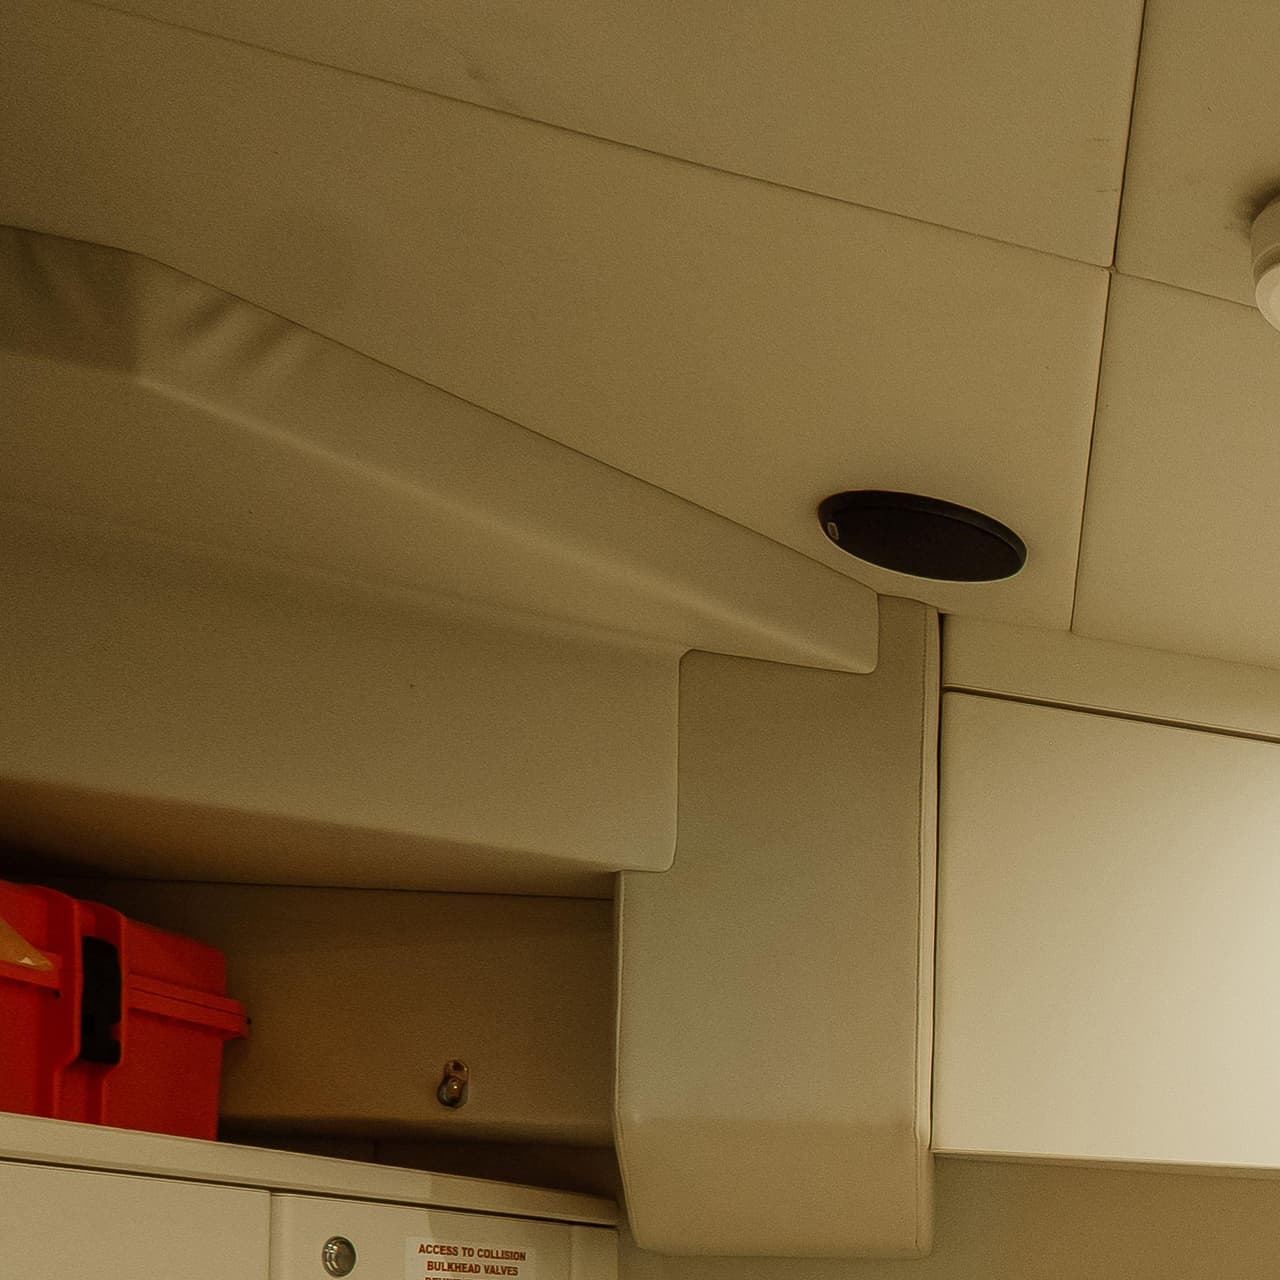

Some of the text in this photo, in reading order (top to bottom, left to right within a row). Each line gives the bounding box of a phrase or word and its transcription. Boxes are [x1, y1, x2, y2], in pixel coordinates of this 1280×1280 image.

[418, 1244, 526, 1261] ACCESS TO COLLISION
[427, 1261, 518, 1276] BULKHEAD VALVES
